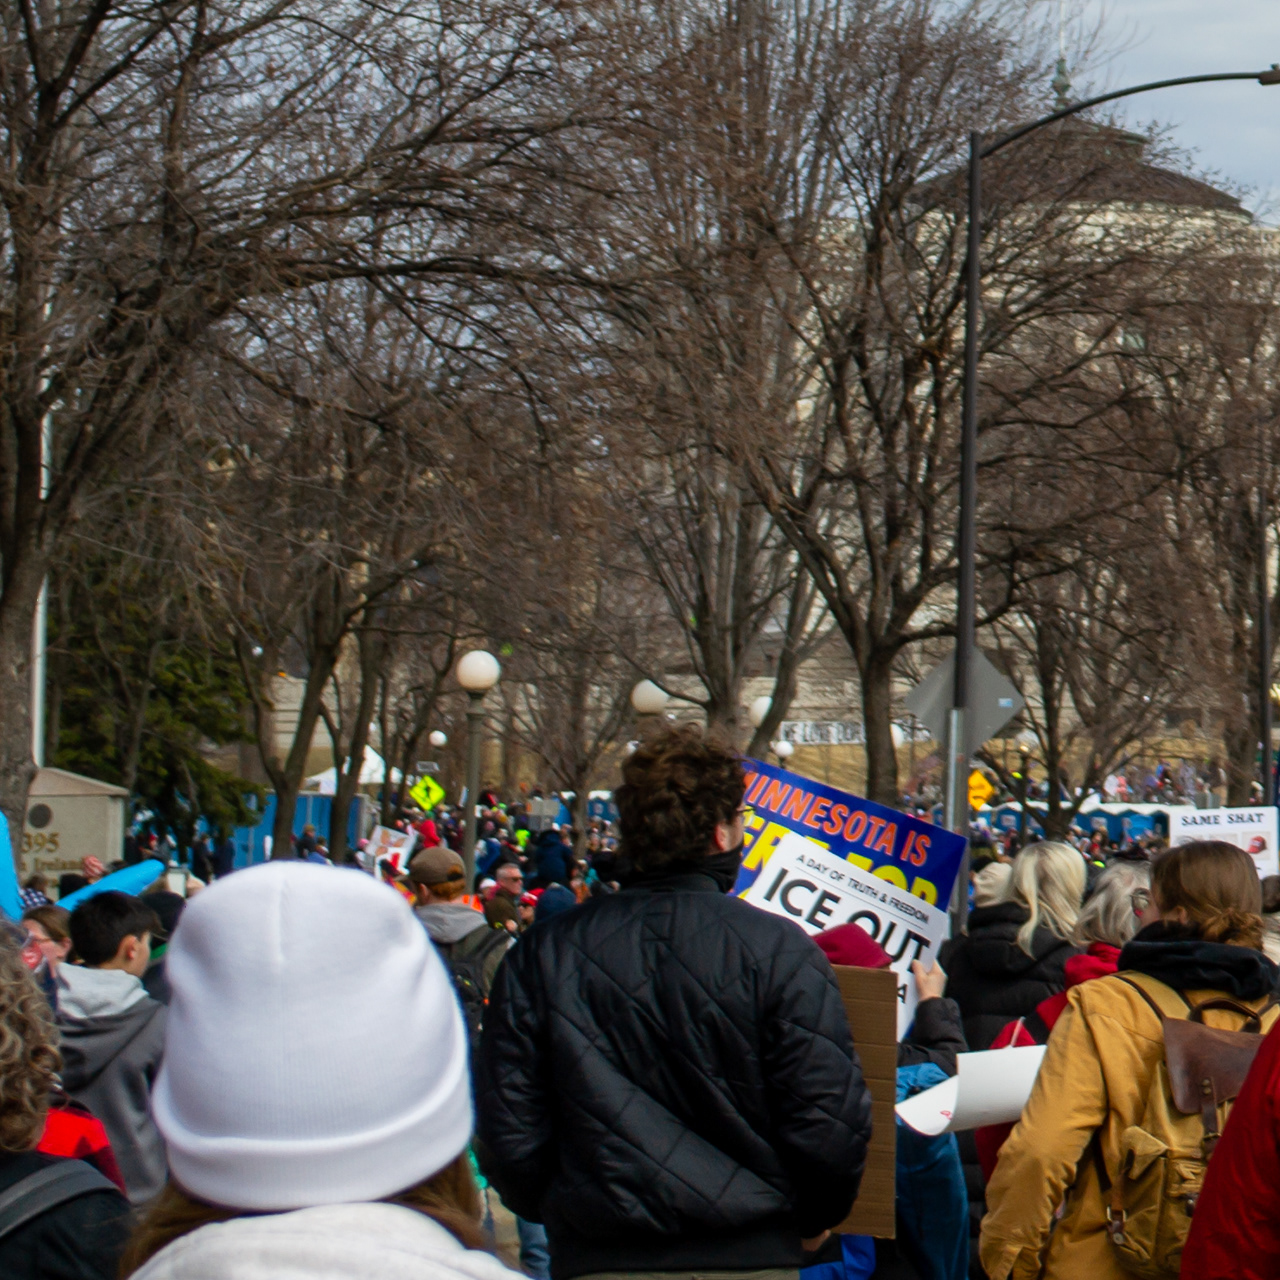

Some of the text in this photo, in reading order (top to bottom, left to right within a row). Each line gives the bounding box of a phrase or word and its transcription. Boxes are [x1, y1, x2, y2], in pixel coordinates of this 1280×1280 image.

[1180, 814, 1221, 827] SAME
[21, 831, 60, 853] 395
[900, 830, 932, 867] IS
[796, 854, 930, 925] A DAY OF TRUTH & FREEDOM
[763, 867, 932, 974] ICE OUT
